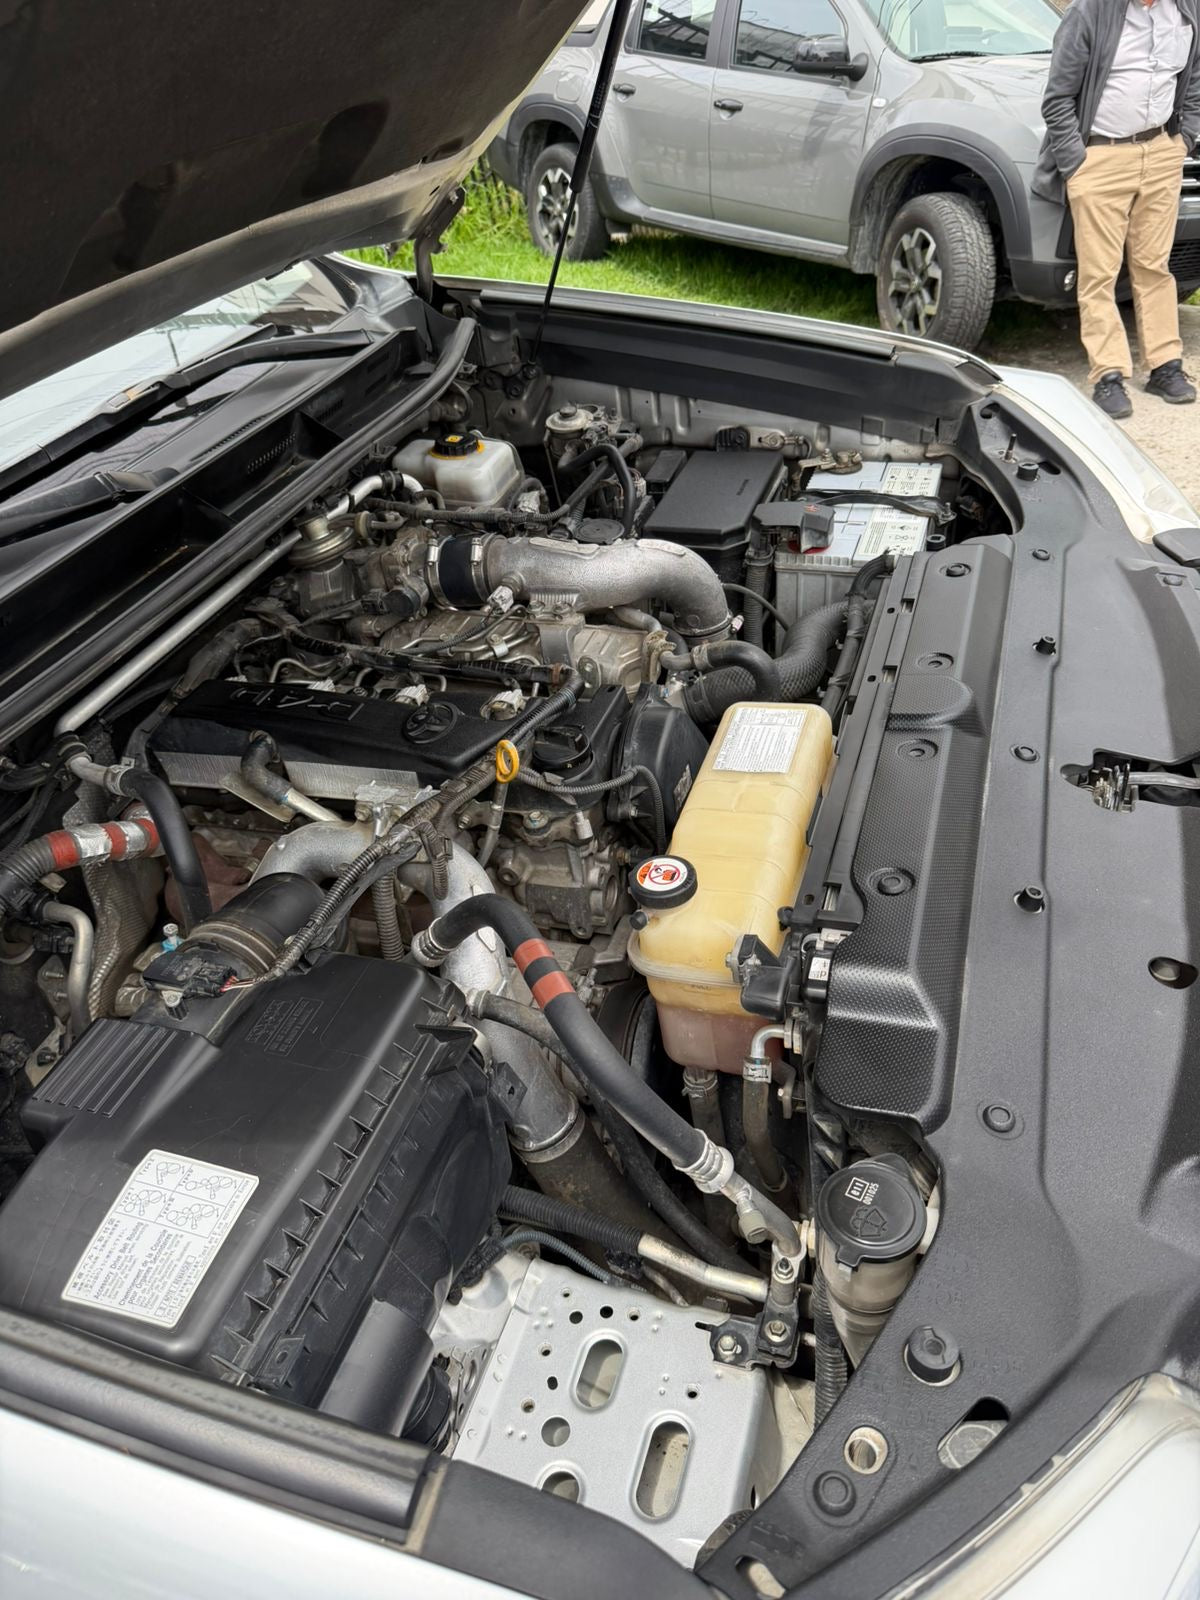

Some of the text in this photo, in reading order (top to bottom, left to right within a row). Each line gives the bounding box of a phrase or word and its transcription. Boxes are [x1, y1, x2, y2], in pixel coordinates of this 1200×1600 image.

[94, 1270, 115, 1299] Accessory
[111, 1254, 123, 1269] Drive
[118, 1242, 130, 1254] Belt
